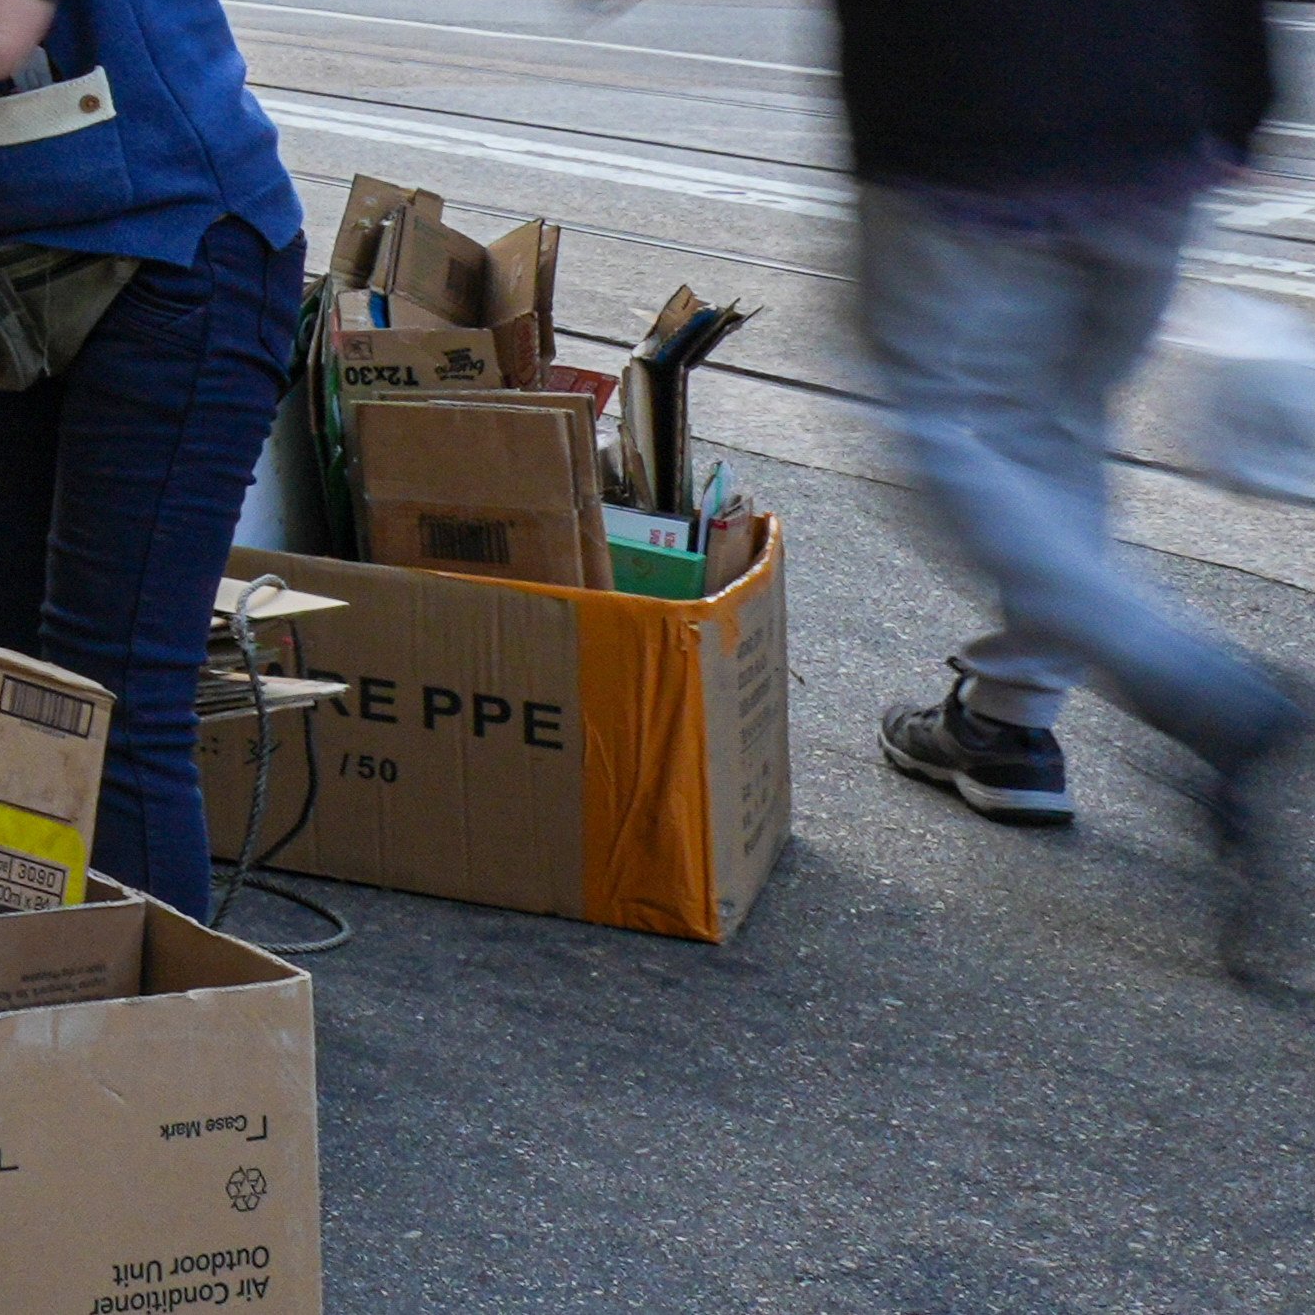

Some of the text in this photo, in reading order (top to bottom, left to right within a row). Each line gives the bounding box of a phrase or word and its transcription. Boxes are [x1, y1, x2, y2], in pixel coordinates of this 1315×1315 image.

[344, 365, 419, 387] T2x30
[422, 684, 564, 750] PPE
[17, 863, 56, 888] 3090
[160, 1114, 248, 1140] Case Mark
[113, 1245, 270, 1285] Outdoor Unit
[92, 1275, 269, 1315] Air Conditioner
